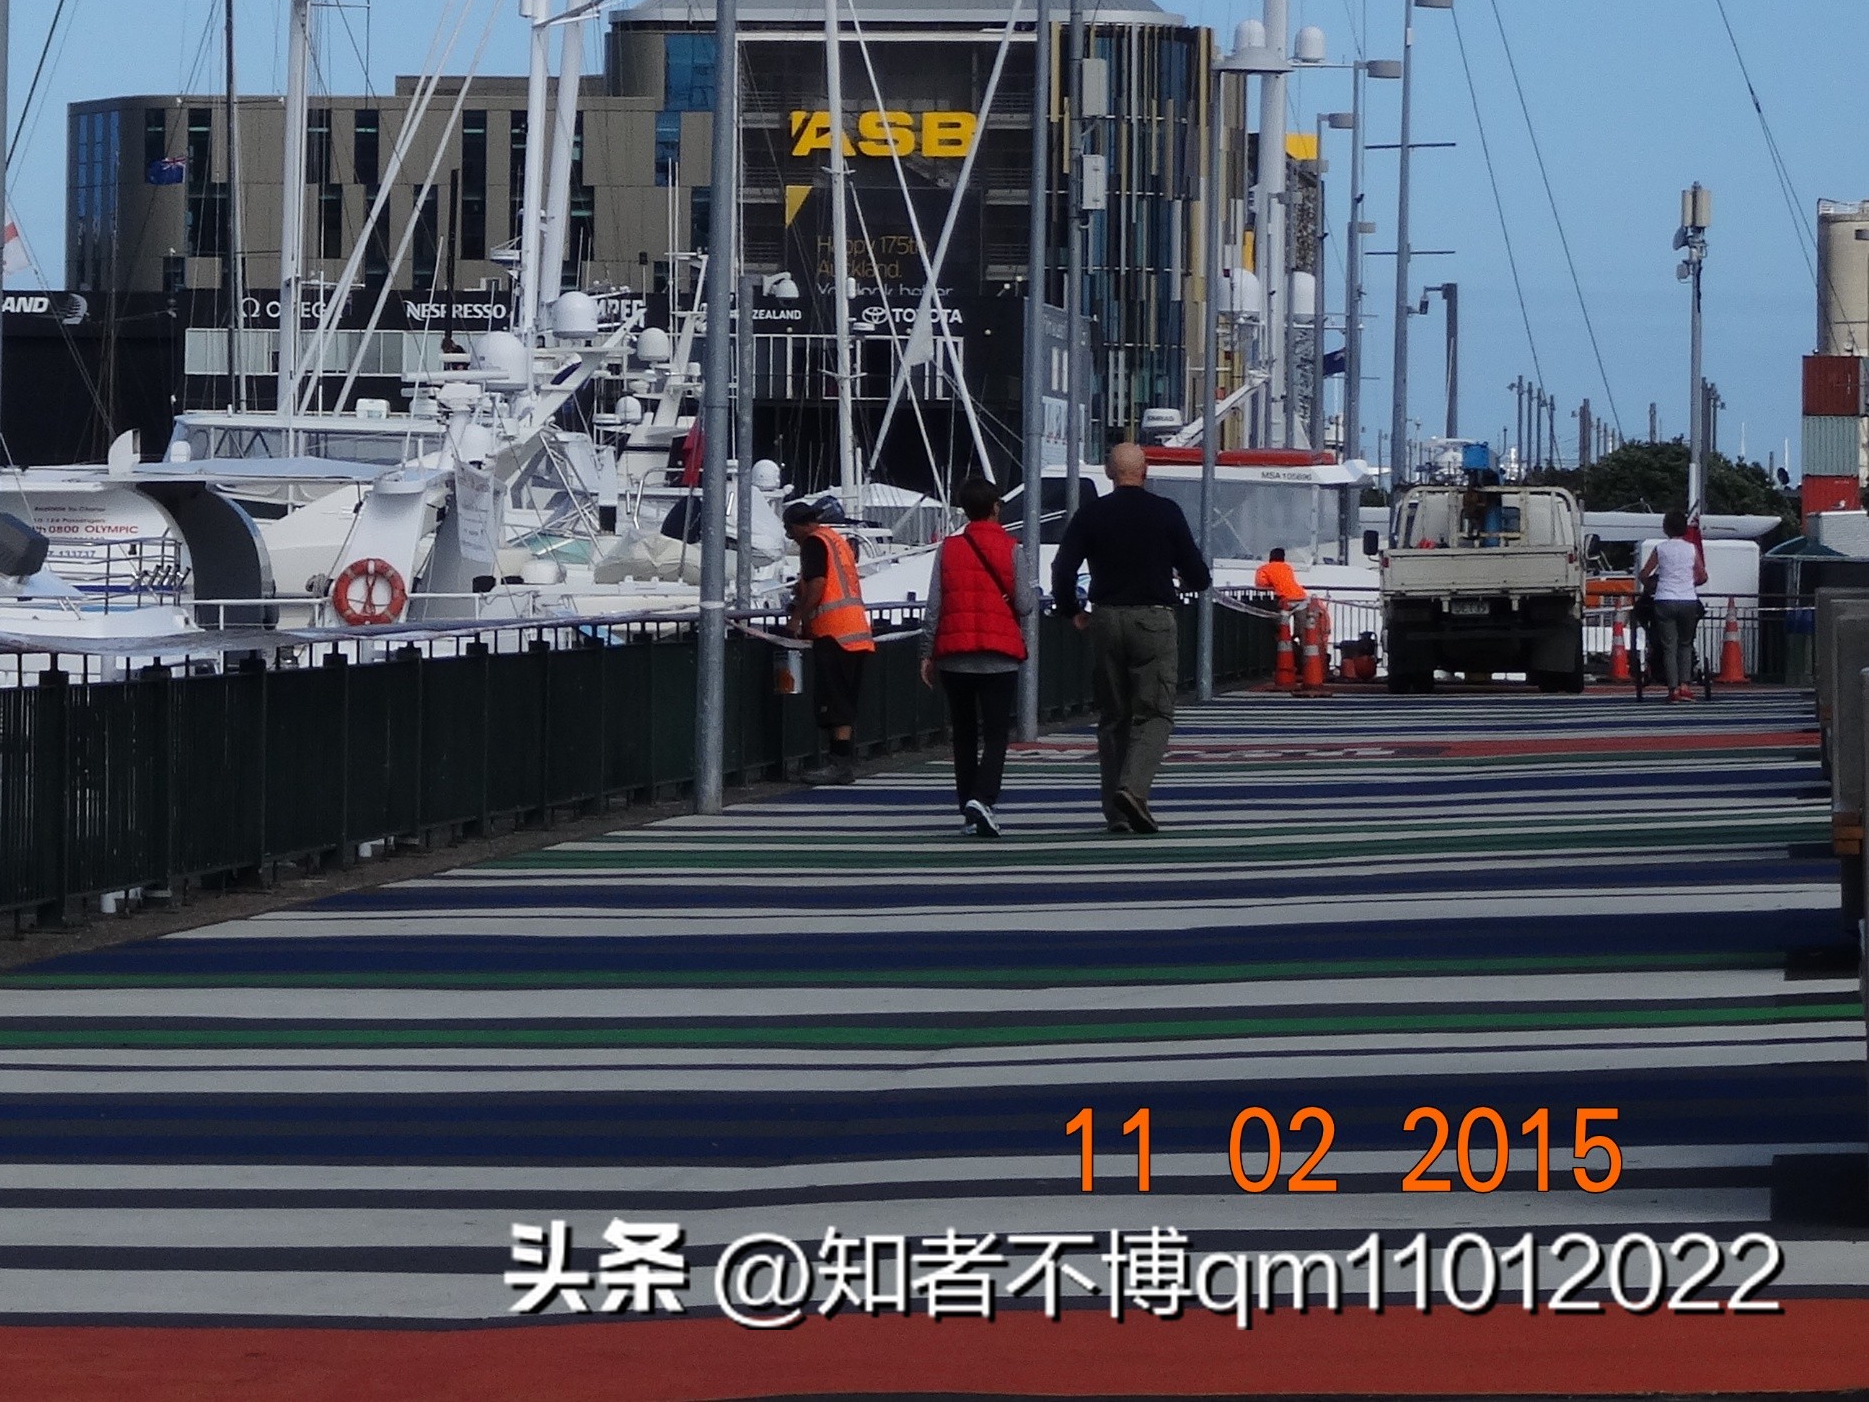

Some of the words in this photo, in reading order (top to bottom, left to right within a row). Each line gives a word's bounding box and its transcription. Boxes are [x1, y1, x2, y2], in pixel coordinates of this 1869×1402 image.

[790, 110, 980, 158] ASB
[817, 235, 876, 257] Hppy
[751, 309, 802, 320] ZEALAND
[891, 308, 963, 324] TOOTA
[48, 525, 79, 534] 0800
[84, 525, 139, 534] OLYMPIC
